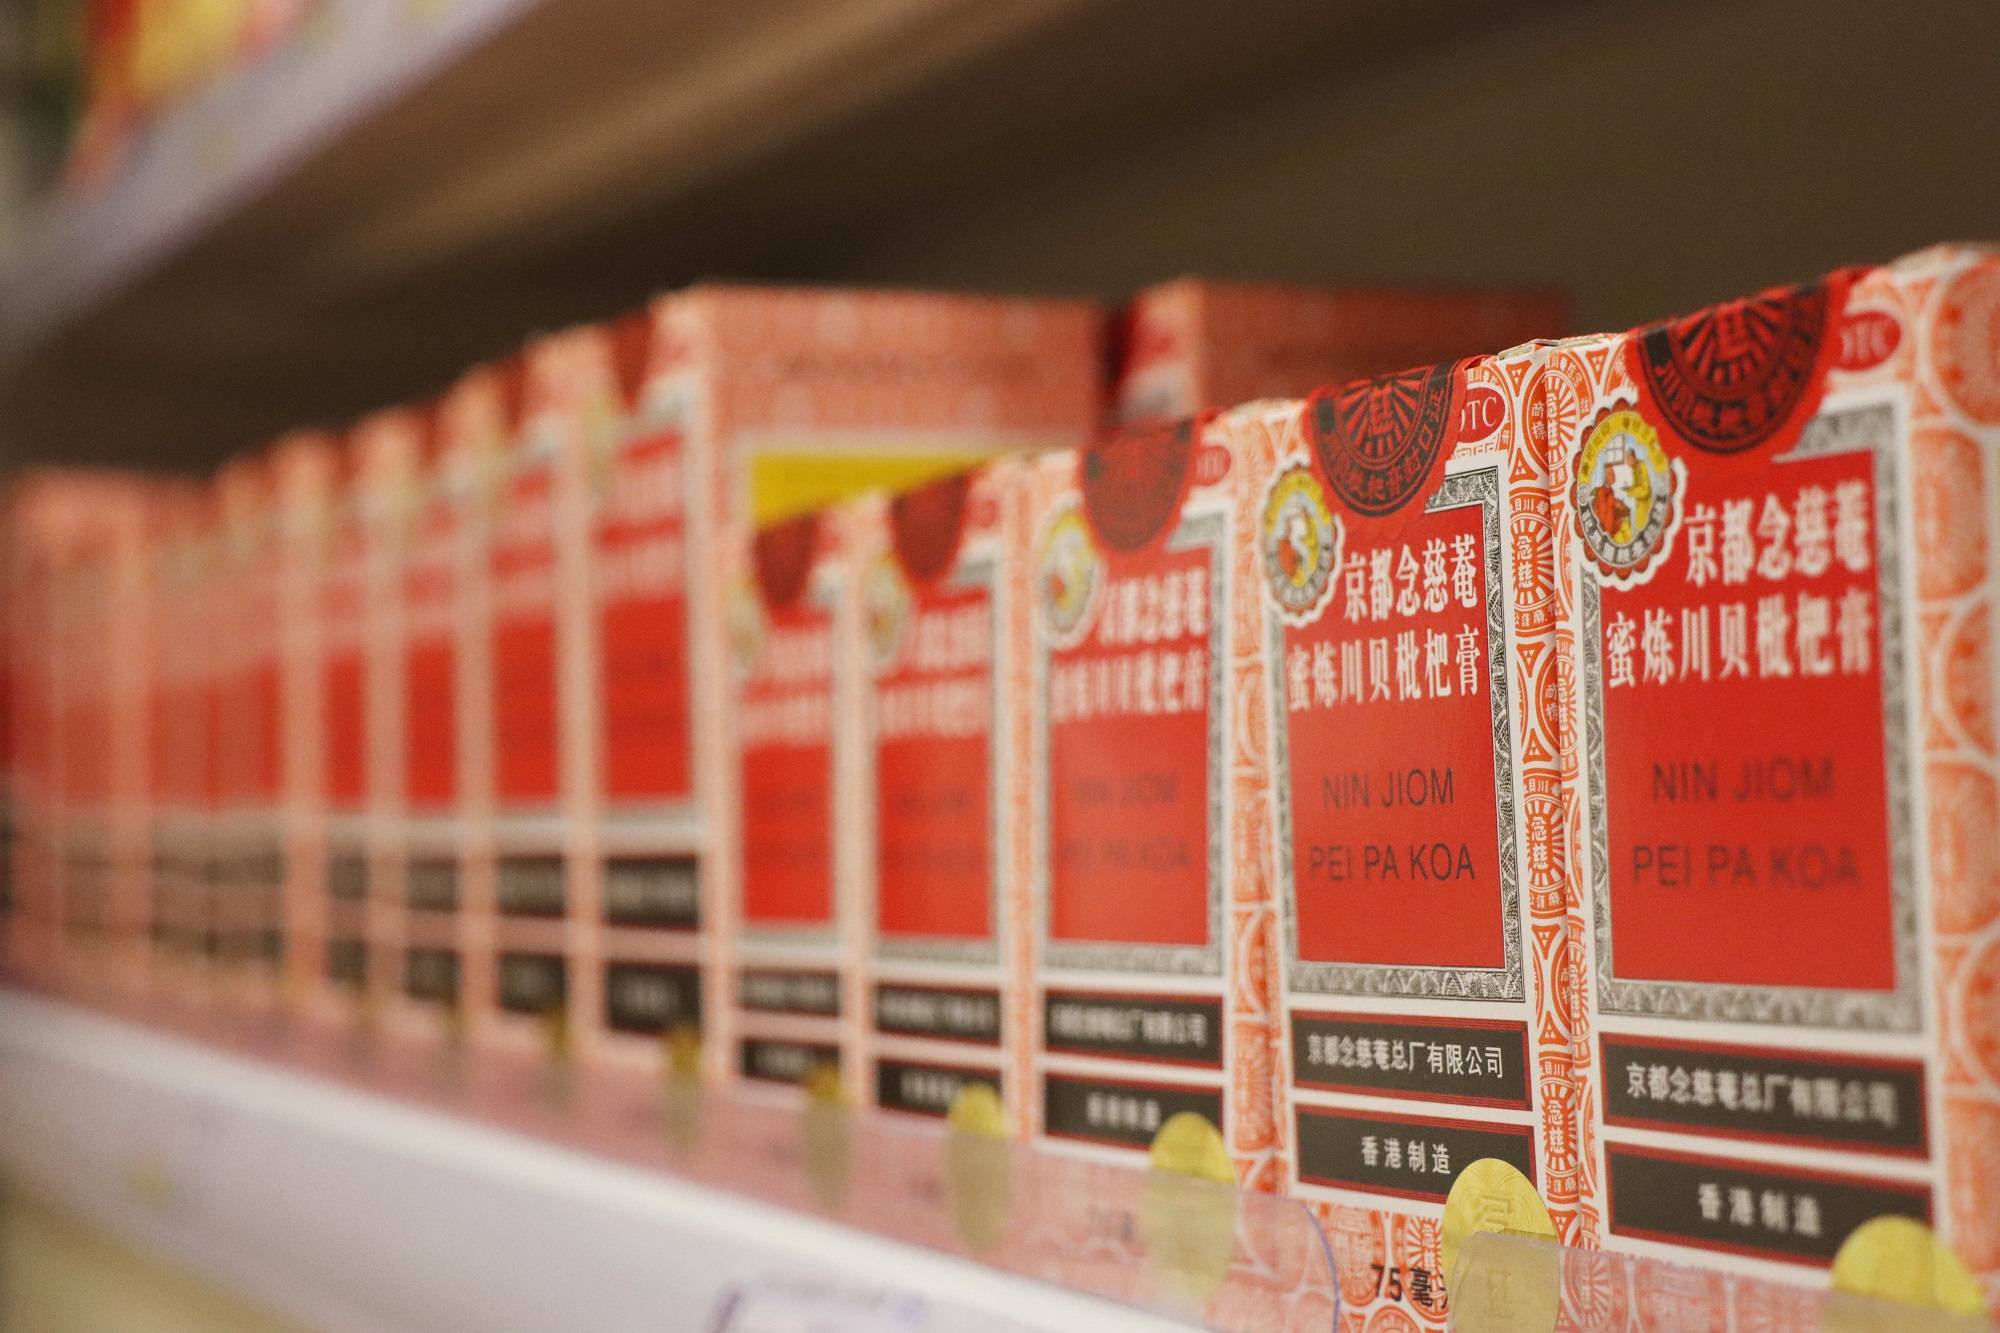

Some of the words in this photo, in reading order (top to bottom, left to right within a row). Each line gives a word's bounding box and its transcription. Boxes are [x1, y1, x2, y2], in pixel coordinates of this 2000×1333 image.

[1343, 534, 1478, 623] 京都念慈菴
[1323, 770, 1370, 808] NIN
[1382, 768, 1455, 807] JIOM
[1652, 761, 1717, 802] NIN
[1732, 756, 1835, 801] JIOM
[1310, 845, 1351, 881] PEI
[1364, 844, 1399, 881] PA
[1410, 843, 1476, 881] KOA
[1632, 845, 1692, 887] PEI
[1708, 845, 1757, 887] PA
[1771, 844, 1862, 890] KOA
[1361, 1136, 1451, 1174] 香港制造
[1370, 1264, 1402, 1302] 75
